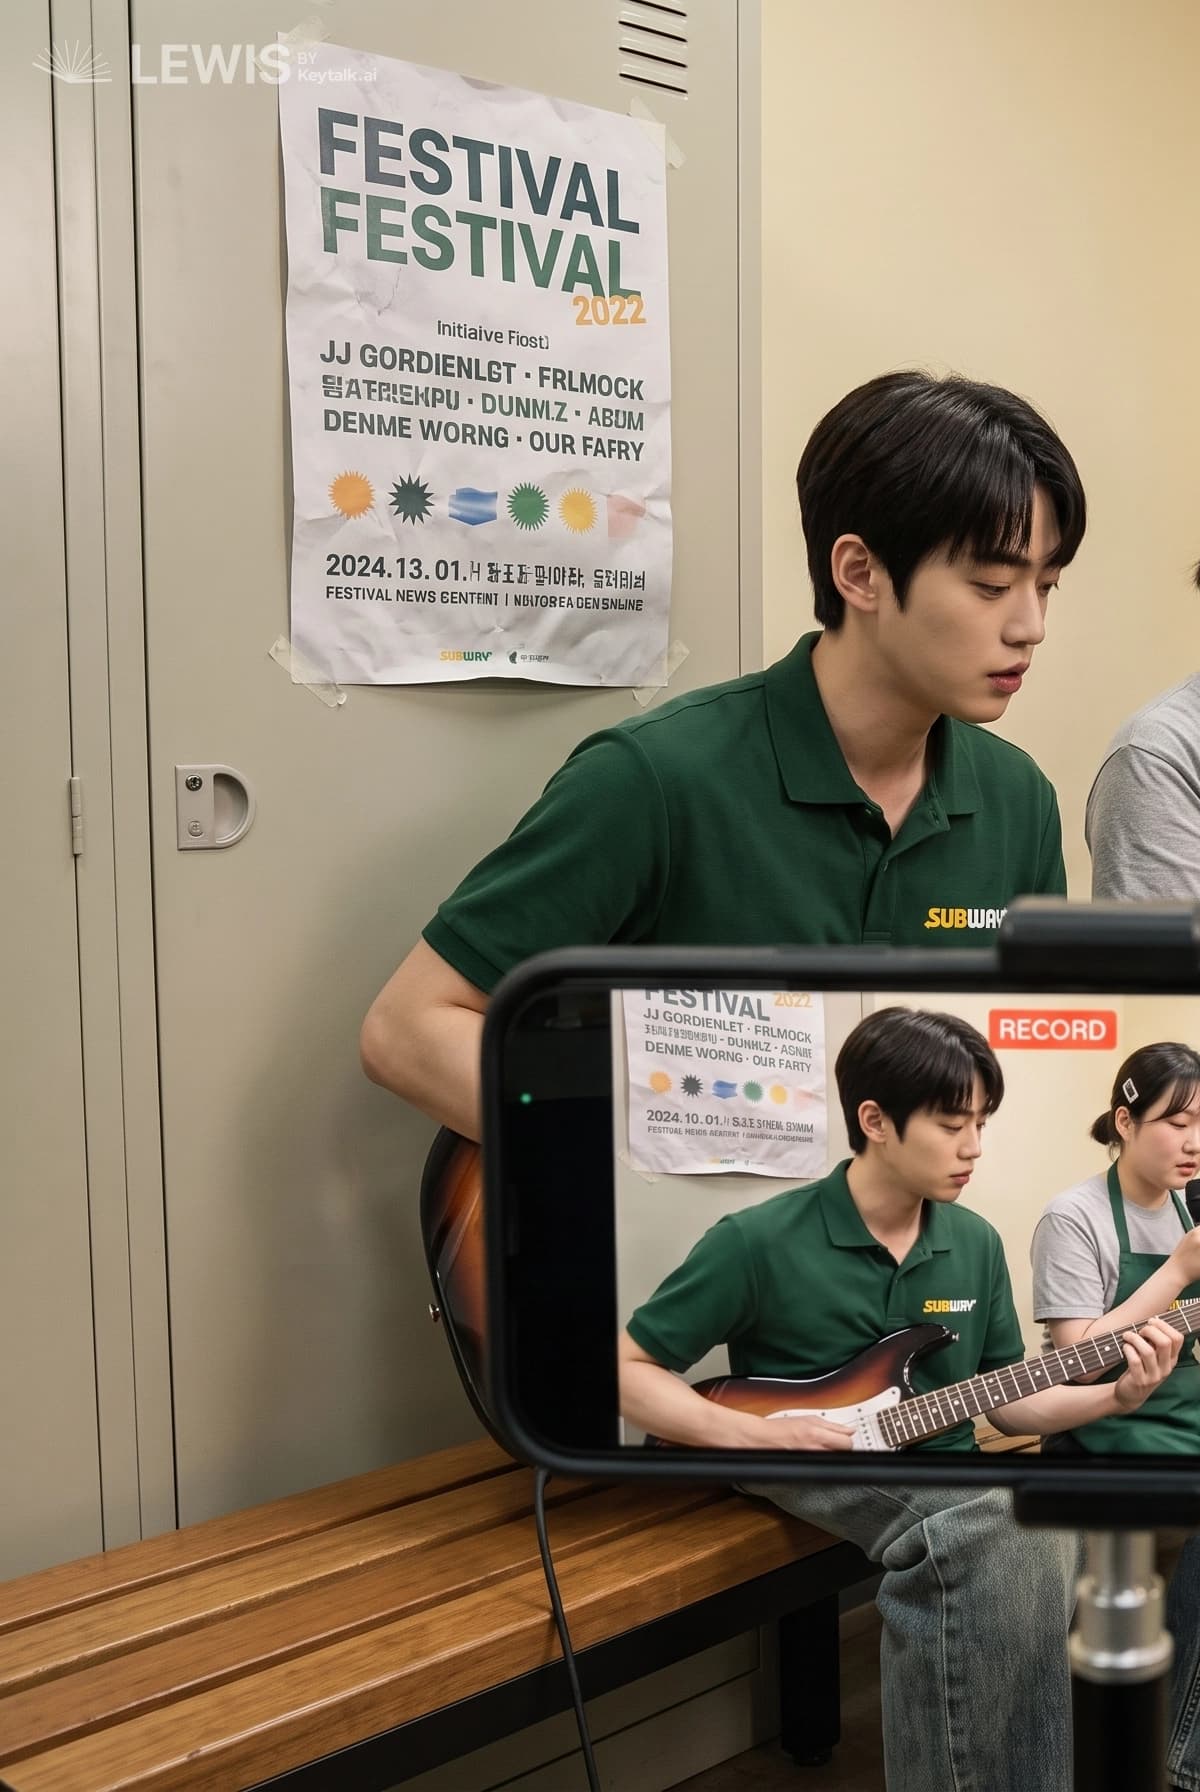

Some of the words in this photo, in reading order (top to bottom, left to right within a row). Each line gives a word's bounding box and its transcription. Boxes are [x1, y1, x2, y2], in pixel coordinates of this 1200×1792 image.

[317, 107, 640, 234] FESTIVAL
[320, 186, 641, 299] FESTIVAL
[571, 294, 647, 326] 2022
[320, 340, 351, 364] JJ
[538, 366, 644, 401] FRLMOCK
[324, 408, 412, 439] DENME
[419, 418, 509, 448] WORNG
[529, 430, 576, 455] OUR
[326, 585, 392, 601] FESTIVAL
[396, 589, 436, 604] NEWS
[643, 1008, 659, 1020] JJ
[1000, 1018, 1106, 1041] RECORD
[645, 1040, 693, 1057] DENME
[695, 1046, 743, 1063] WORNG
